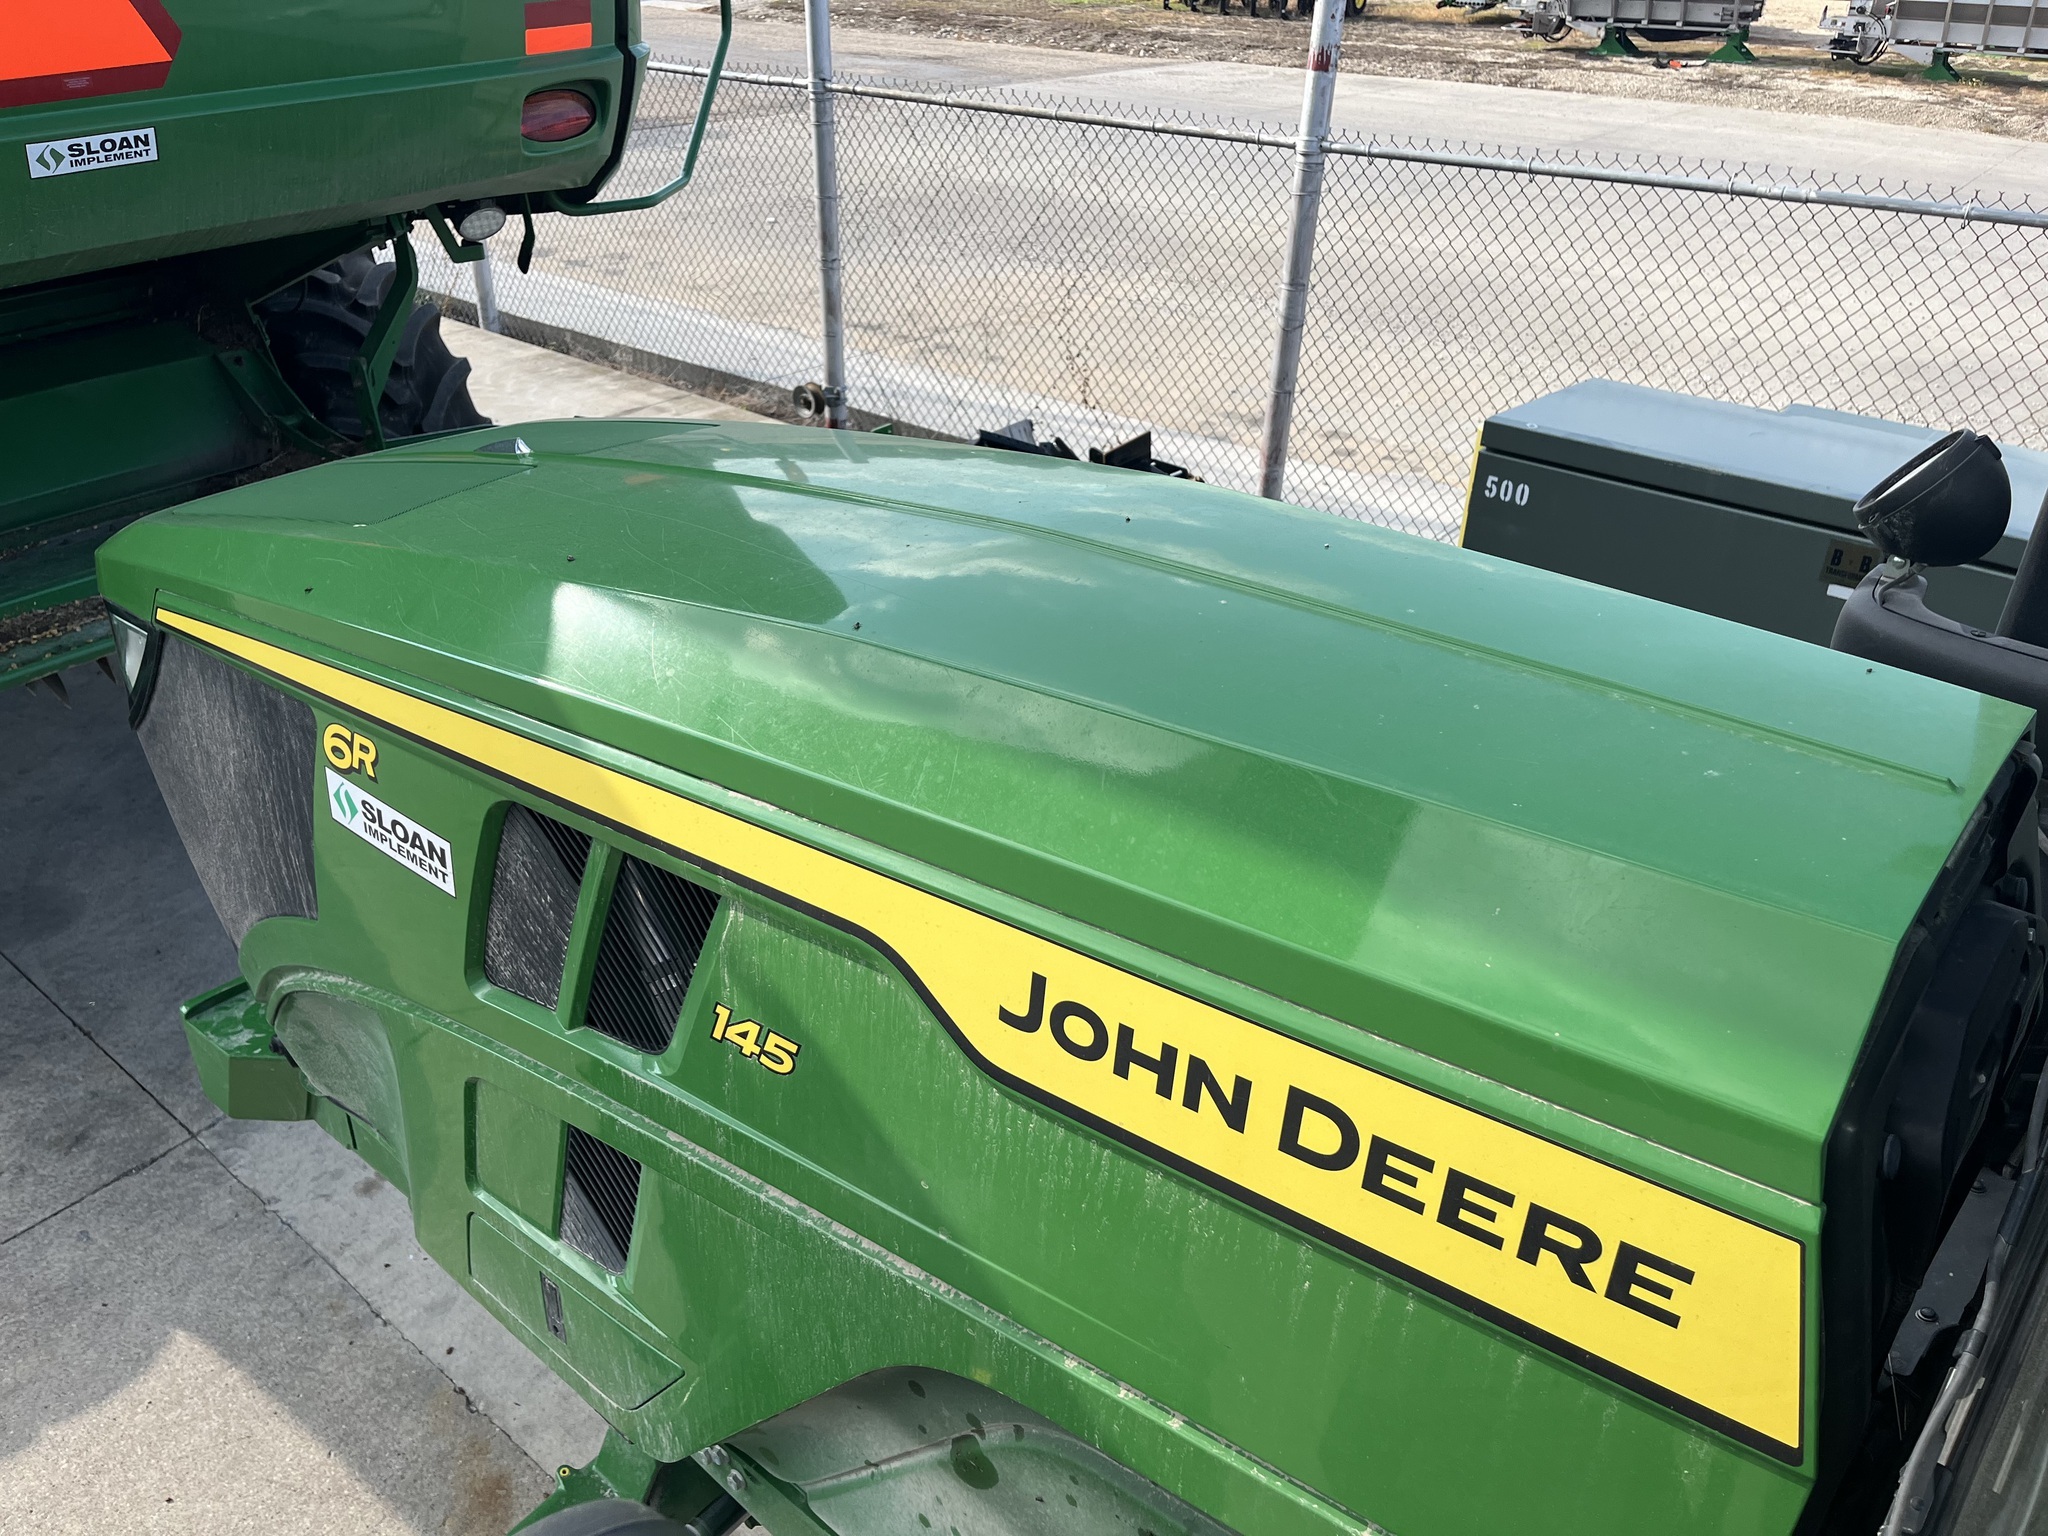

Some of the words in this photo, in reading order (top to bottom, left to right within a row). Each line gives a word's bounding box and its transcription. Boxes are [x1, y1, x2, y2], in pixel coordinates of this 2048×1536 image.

[67, 134, 150, 157] SLOAN
[70, 149, 151, 168] IMPLEMENT
[1484, 475, 1530, 506] 500
[1830, 548, 1844, 566] B
[1859, 555, 1873, 573] B
[322, 722, 379, 784] 6R
[361, 799, 448, 869] SLOAN
[363, 821, 449, 884] IMPLEMENT
[710, 1001, 802, 1075] 145
[998, 971, 1253, 1134] JOHN
[1278, 1084, 1696, 1330] DEERE
